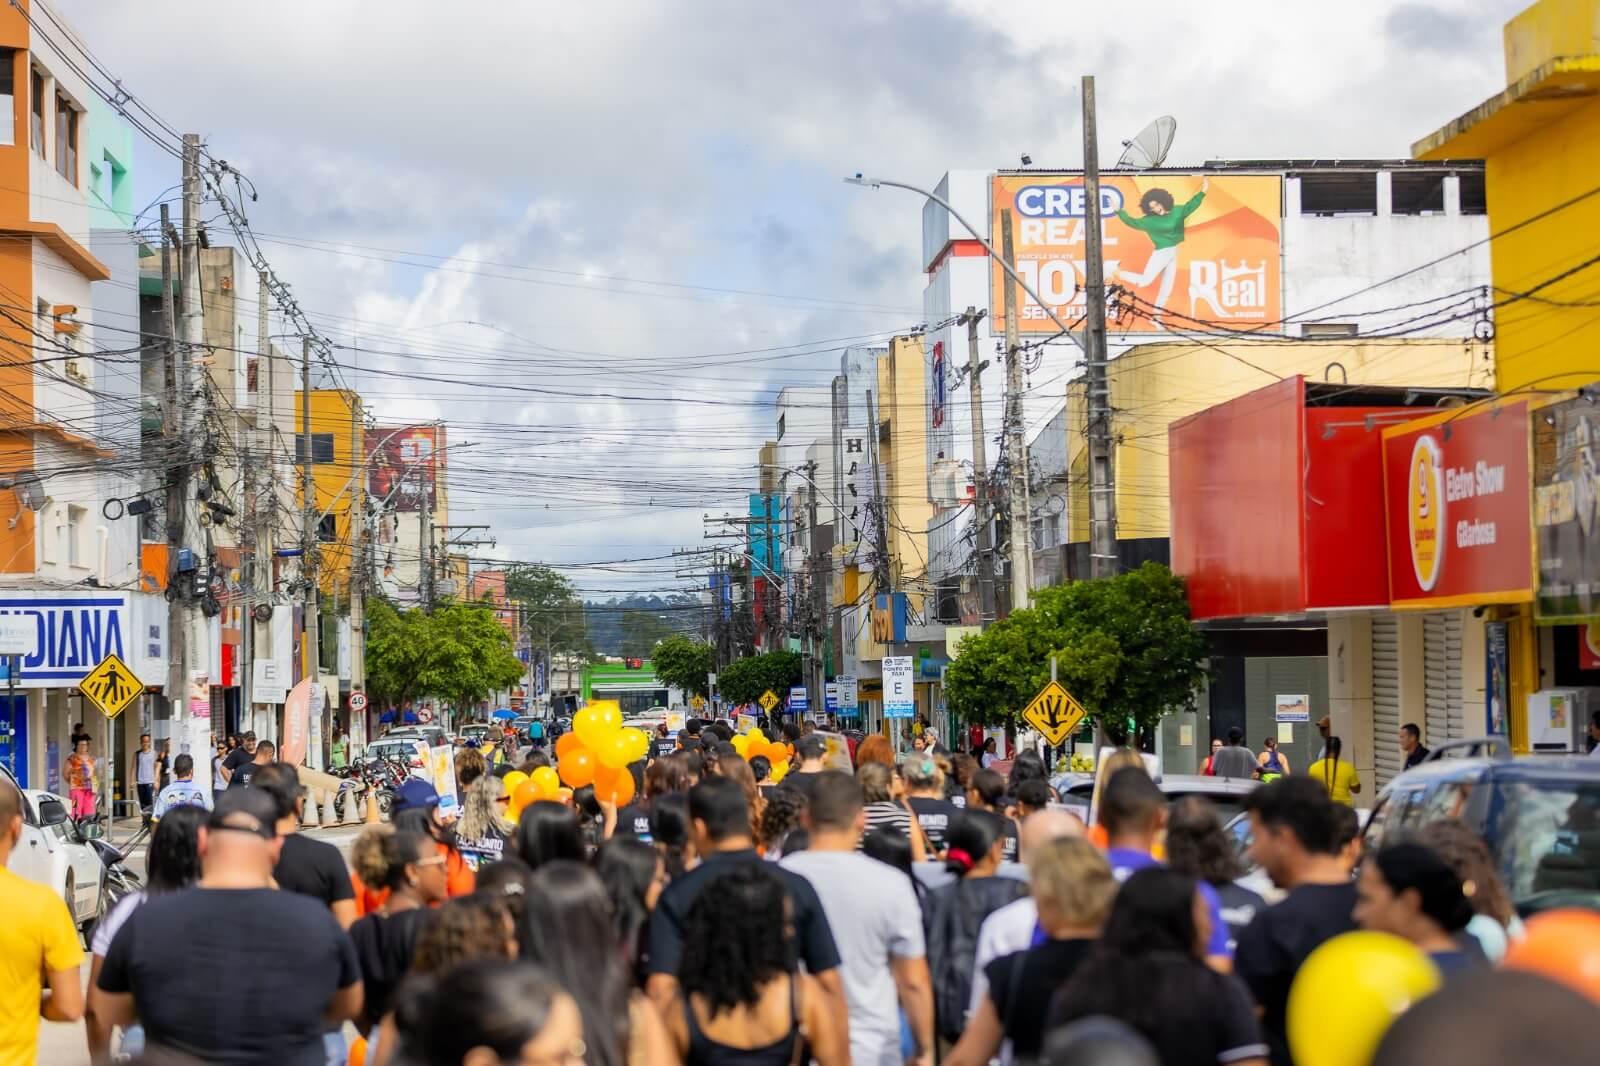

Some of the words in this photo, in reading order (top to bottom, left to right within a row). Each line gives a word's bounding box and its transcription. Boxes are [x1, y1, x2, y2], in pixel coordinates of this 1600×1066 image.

[1018, 188, 1121, 216] CRED
[1020, 219, 1119, 246] REAL
[1188, 260, 1265, 319] Real
[1475, 460, 1505, 497] Show
[1, 610, 125, 668] DIANA
[264, 665, 276, 680] E
[351, 696, 364, 706] 40
[844, 691, 851, 702] E
[894, 682, 903, 695] E
